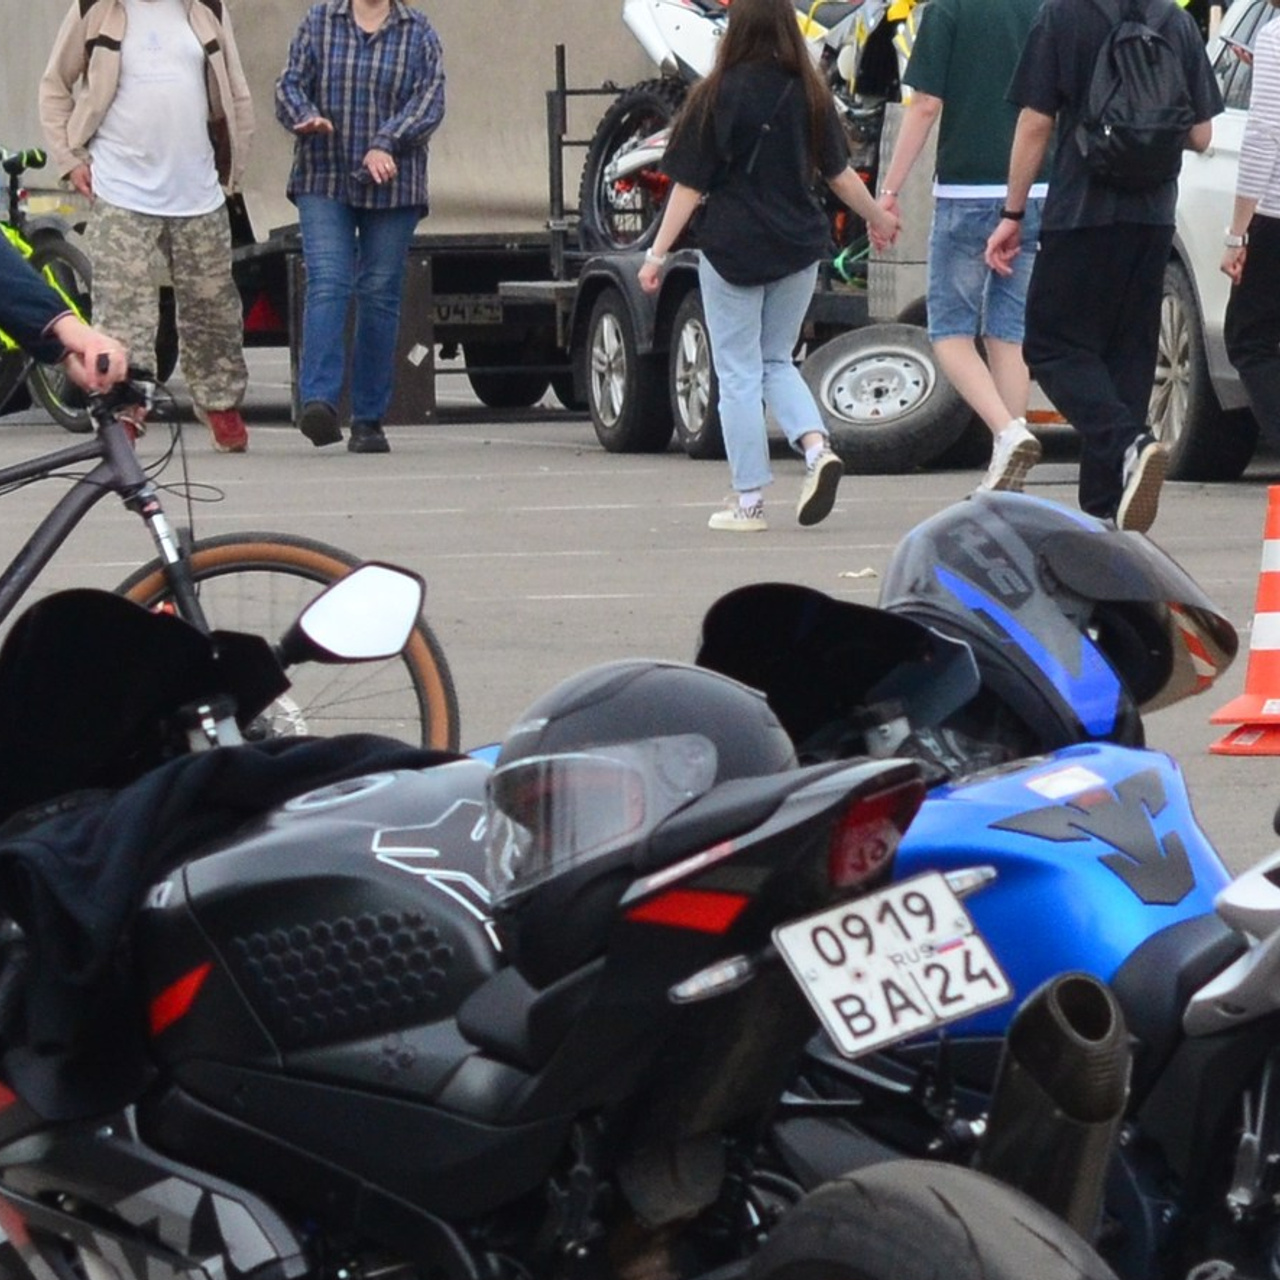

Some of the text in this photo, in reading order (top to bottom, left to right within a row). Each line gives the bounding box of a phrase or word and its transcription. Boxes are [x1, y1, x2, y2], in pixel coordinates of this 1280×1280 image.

[811, 891, 936, 967] 0919
[889, 943, 935, 968] RUS
[923, 949, 998, 1006] 24
